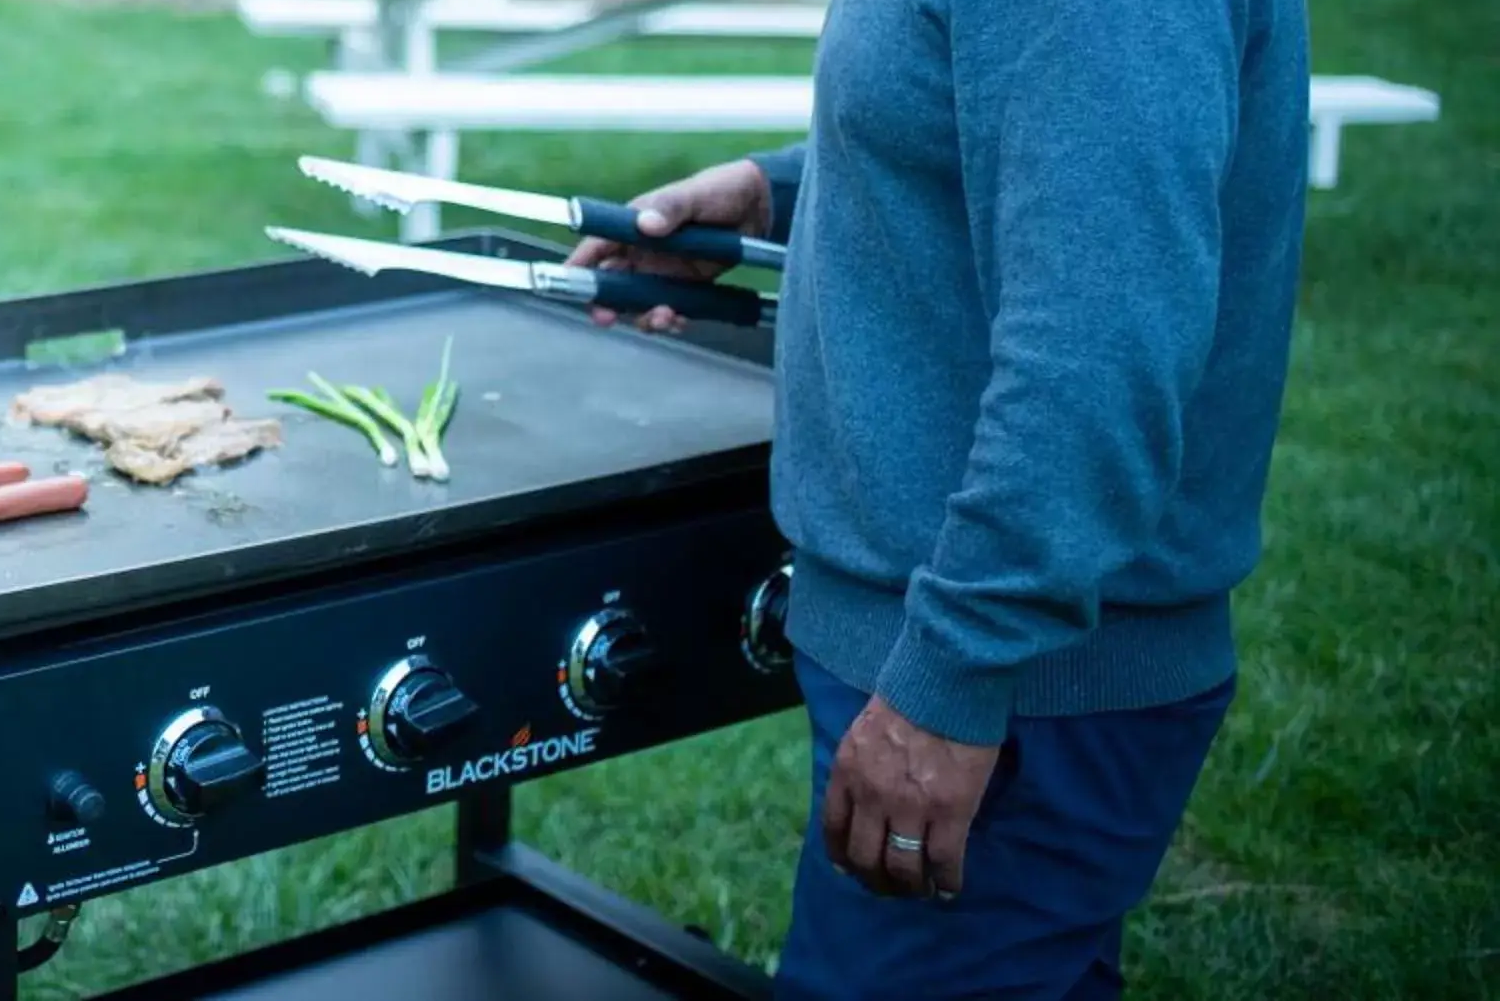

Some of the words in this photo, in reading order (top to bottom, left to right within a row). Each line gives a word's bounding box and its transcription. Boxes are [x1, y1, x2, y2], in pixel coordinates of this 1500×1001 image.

[406, 635, 426, 650] OFF
[189, 685, 210, 700] OFF
[426, 727, 600, 794] BLACKSTONE
